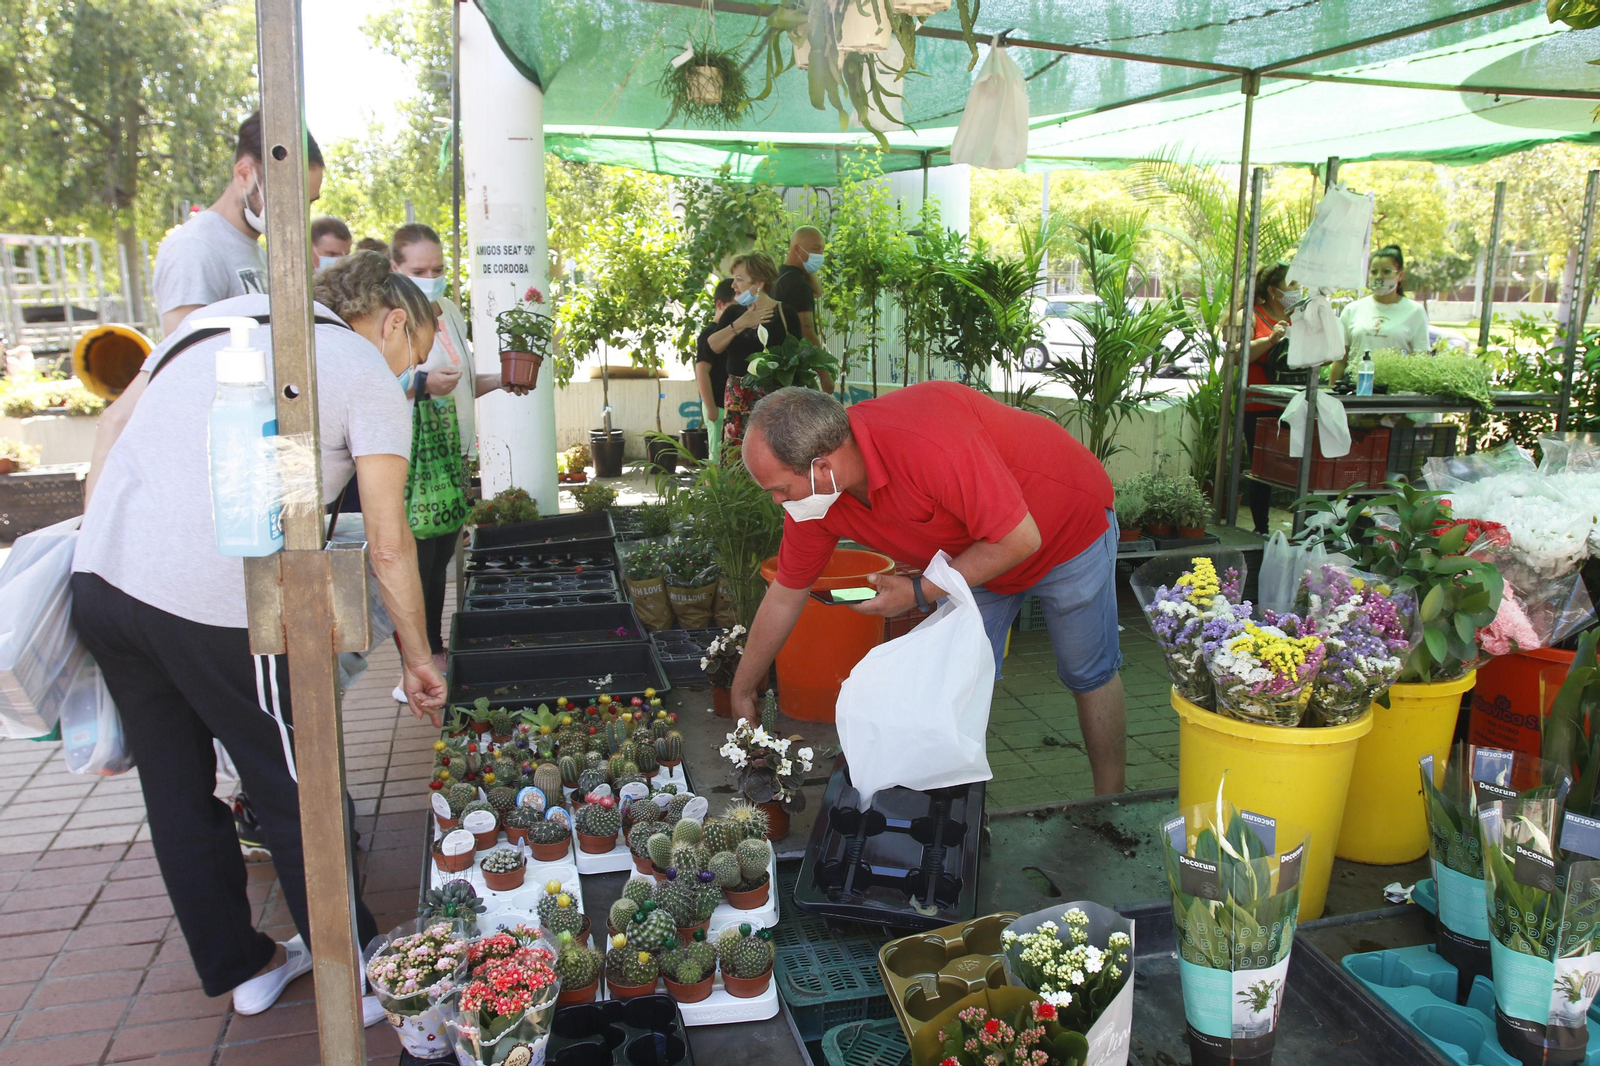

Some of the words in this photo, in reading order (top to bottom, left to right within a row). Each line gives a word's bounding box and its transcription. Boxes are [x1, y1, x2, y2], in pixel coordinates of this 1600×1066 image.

[476, 245, 501, 256] AMIGOS
[503, 245, 522, 256] SEAT
[482, 263, 492, 274] DE
[493, 263, 529, 274] CORDOBA
[643, 585, 663, 594] LOVE
[688, 592, 707, 601] LOVE
[1479, 782, 1517, 798] Decorum
[1516, 845, 1555, 867] Decorum
[1180, 855, 1217, 872] Decorum
